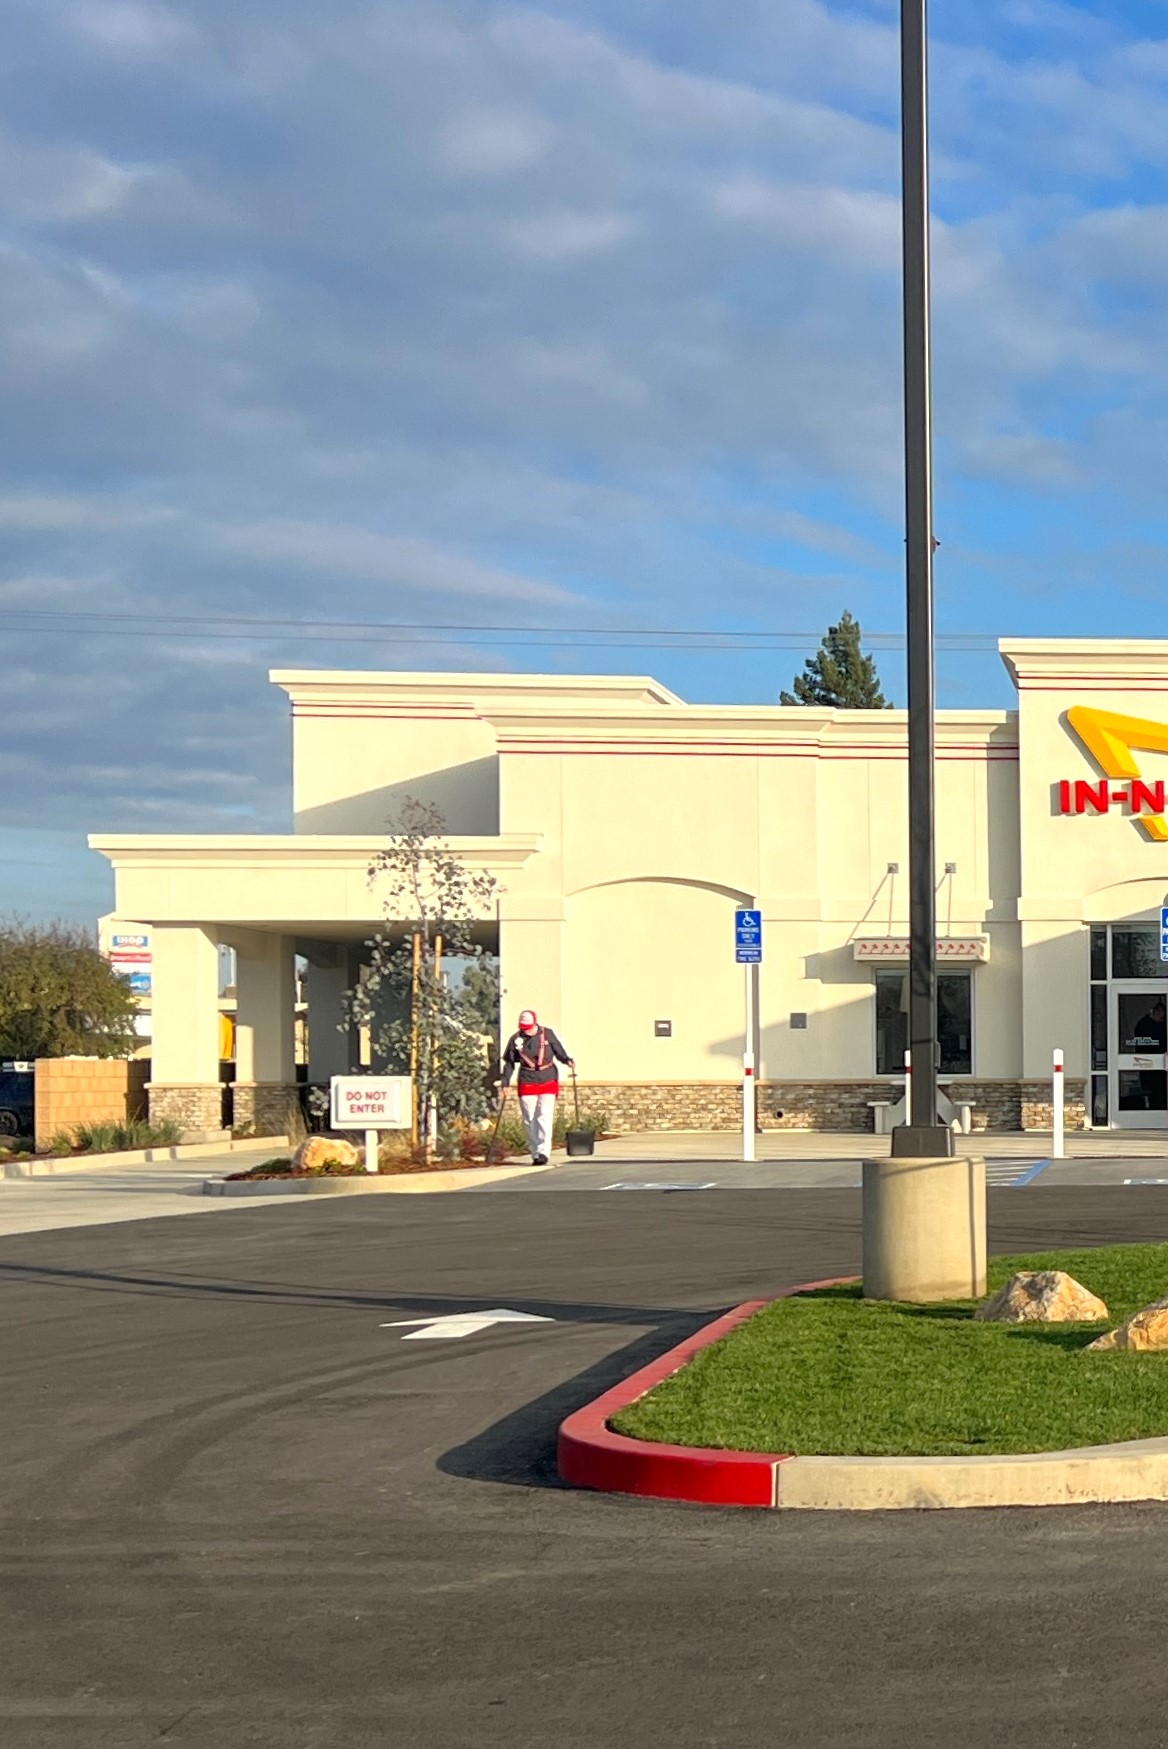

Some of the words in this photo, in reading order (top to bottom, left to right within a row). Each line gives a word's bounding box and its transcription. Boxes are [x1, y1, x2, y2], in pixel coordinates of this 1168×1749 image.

[346, 1091, 362, 1101] DO
[365, 1091, 387, 1100] NOT
[350, 1104, 385, 1113] ENTER
